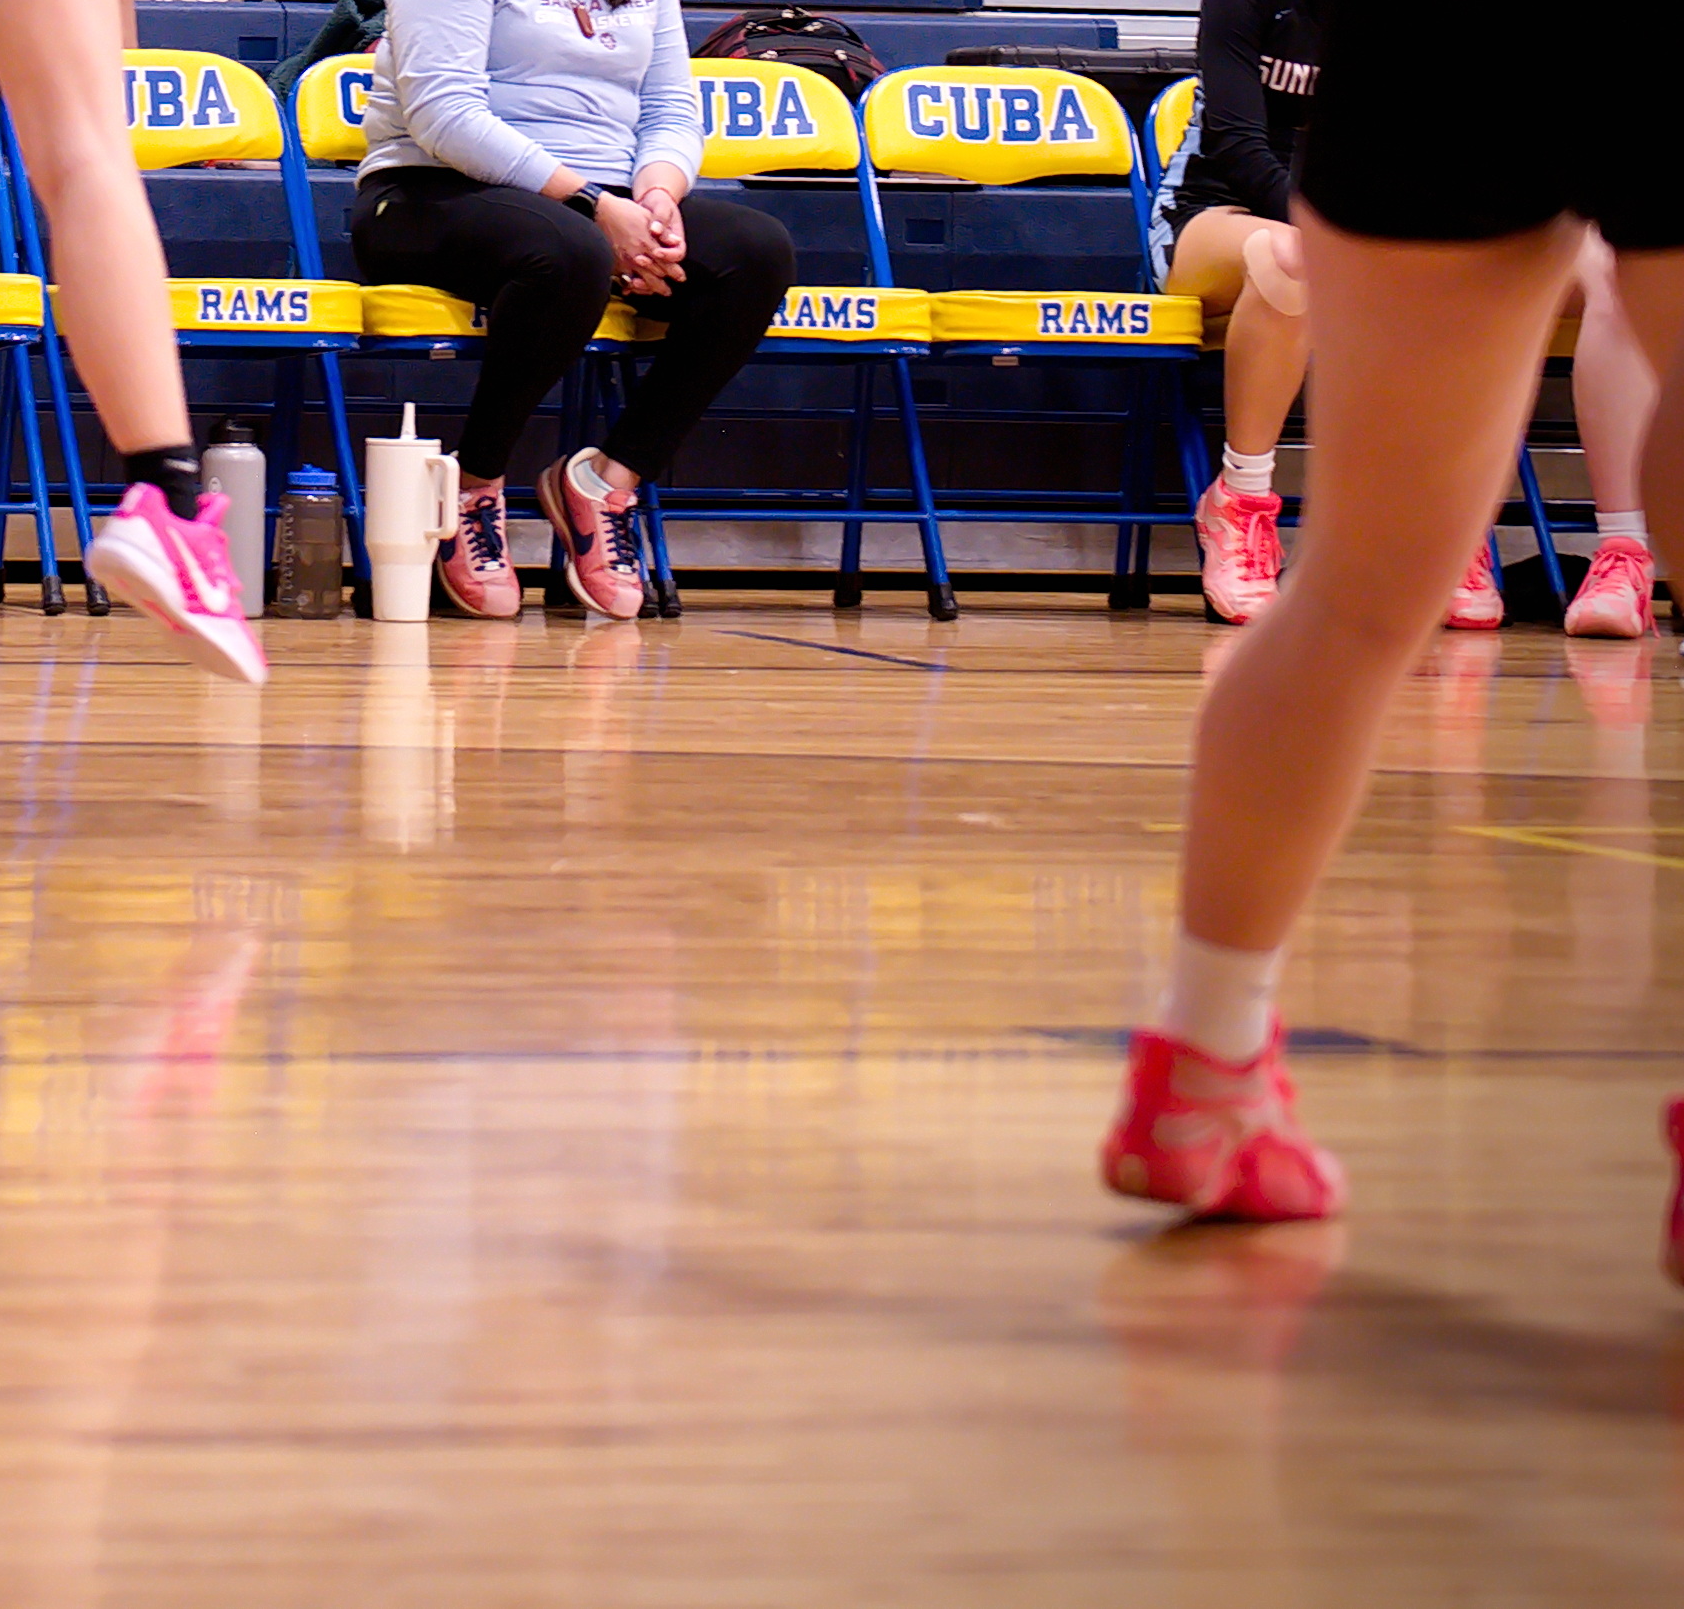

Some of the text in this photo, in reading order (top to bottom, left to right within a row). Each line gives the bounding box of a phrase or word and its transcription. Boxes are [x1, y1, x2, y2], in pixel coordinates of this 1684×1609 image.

[907, 81, 1097, 143] CUBA
[199, 288, 310, 324] RAMS
[1039, 302, 1151, 335] RAMS
